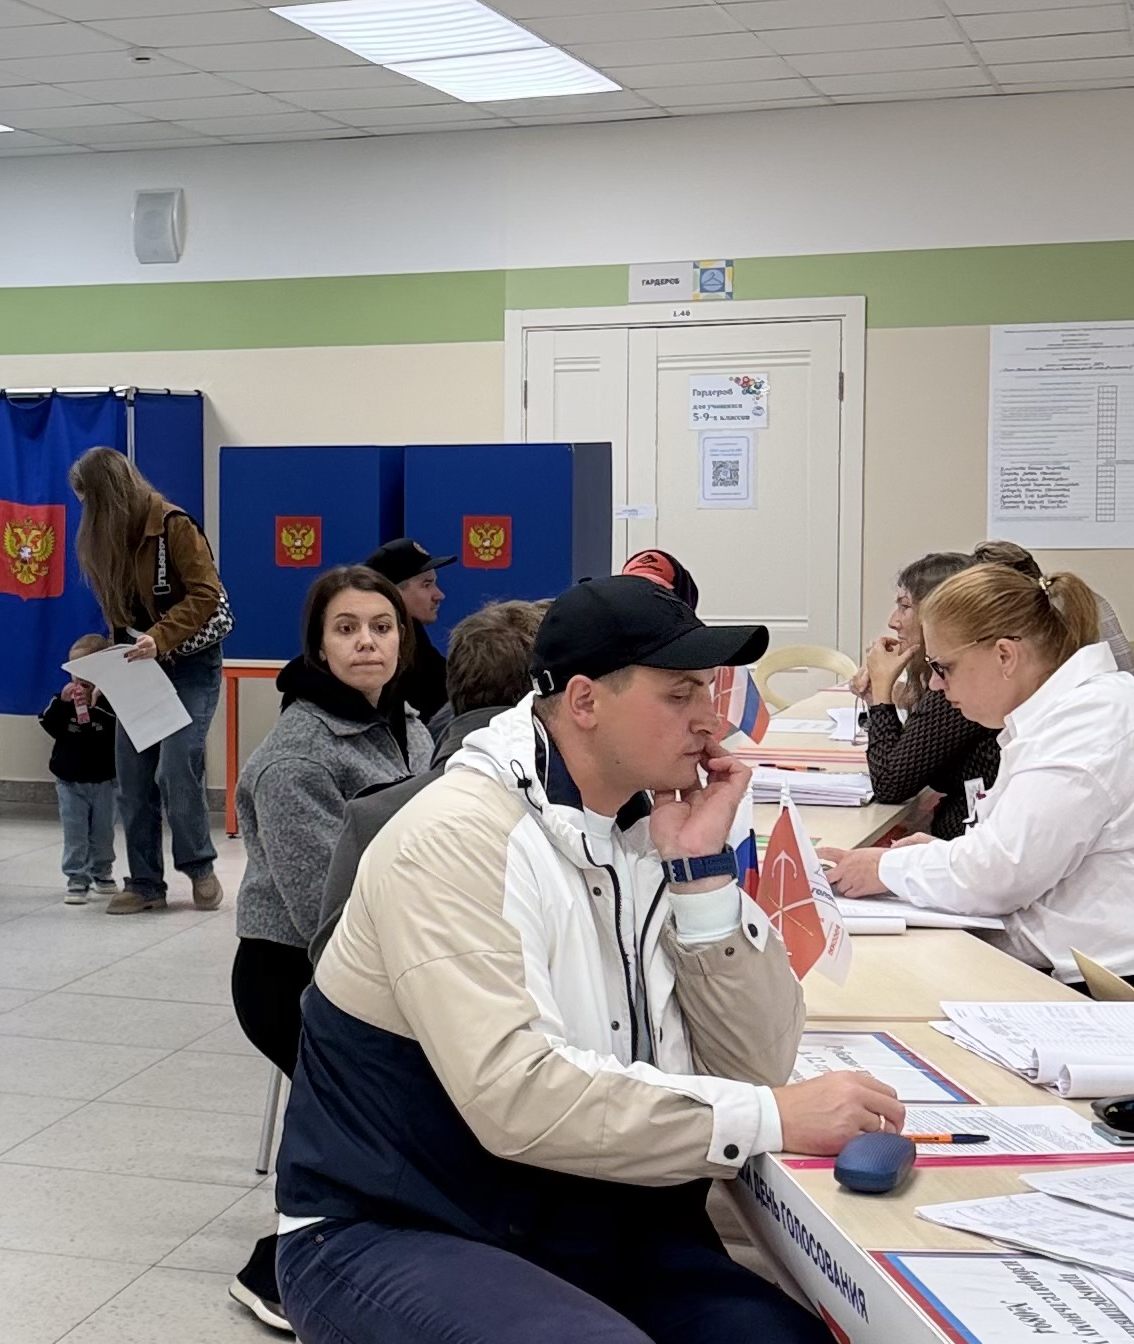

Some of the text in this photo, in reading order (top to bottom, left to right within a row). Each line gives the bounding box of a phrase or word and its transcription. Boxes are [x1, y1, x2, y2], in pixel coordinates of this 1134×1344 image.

[641, 277, 681, 287] ГАРДЕРОБ
[753, 1170, 870, 1325] ДЕНЬ ГОЛОСОВАНИЯ
[1000, 1260, 1103, 1338] избирательному
